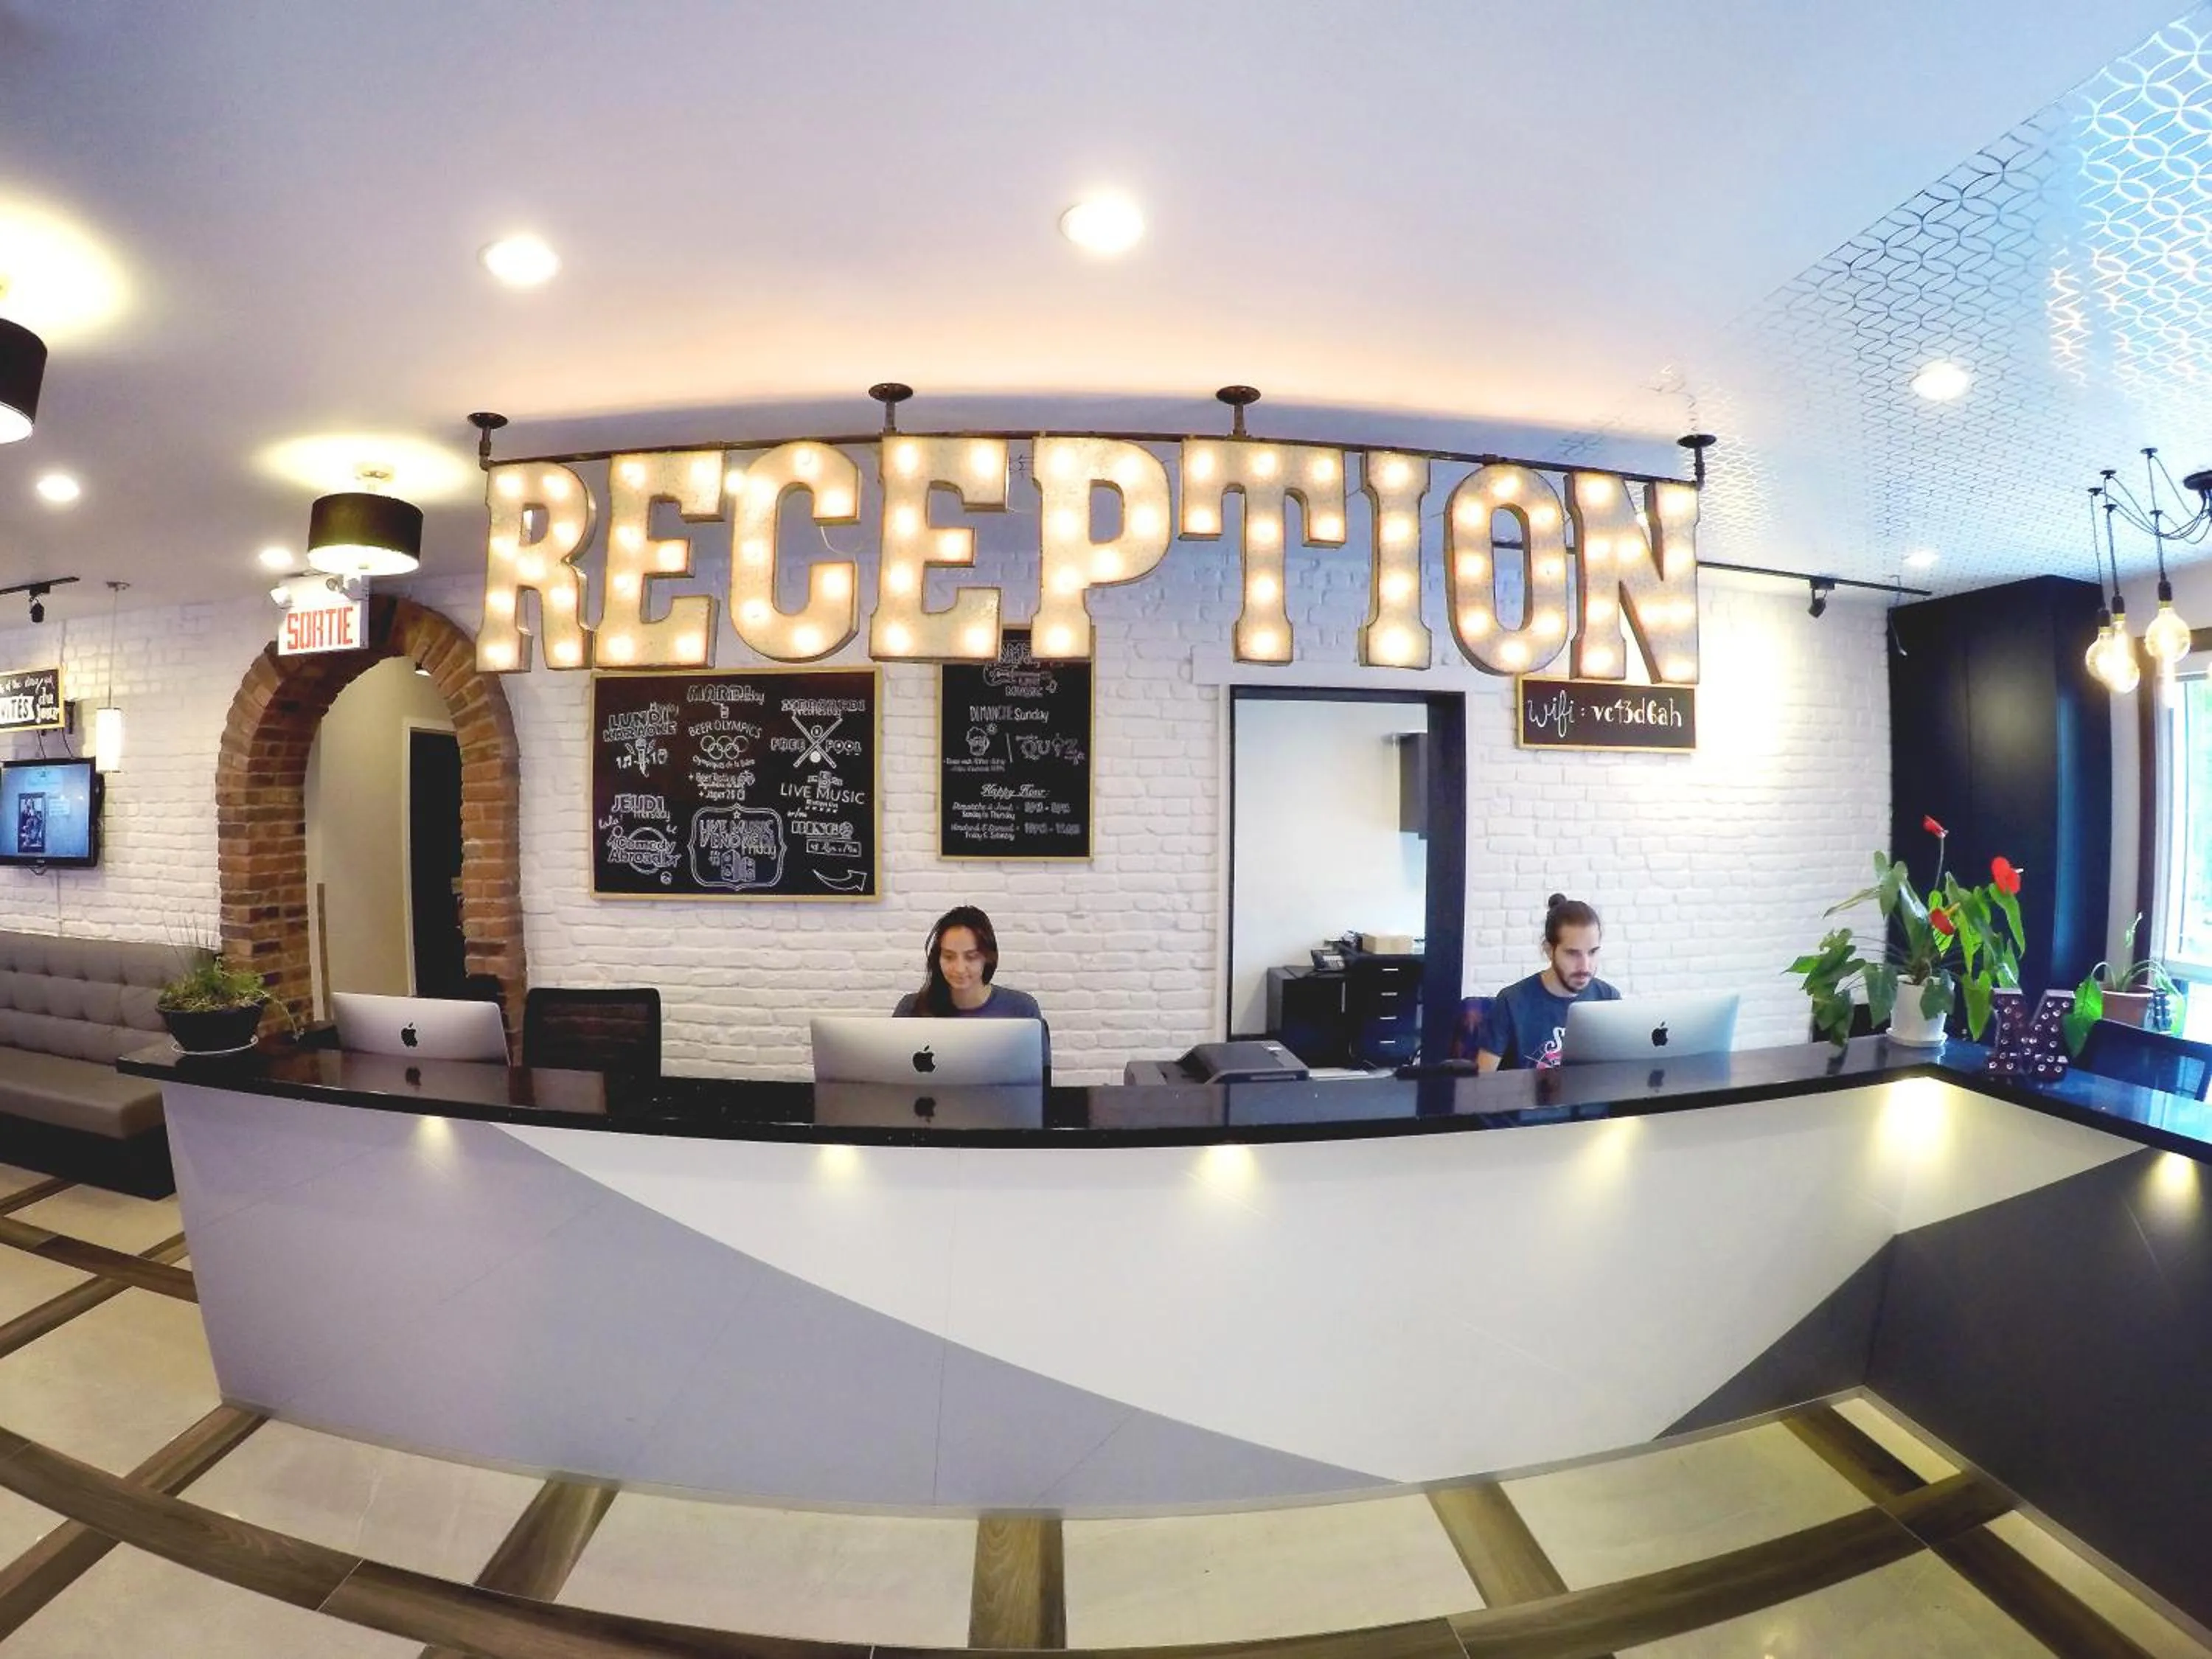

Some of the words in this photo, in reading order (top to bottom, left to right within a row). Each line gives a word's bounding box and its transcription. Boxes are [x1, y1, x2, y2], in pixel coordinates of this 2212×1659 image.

[474, 435, 1700, 685] RECEPTION
[287, 606, 354, 650] SORTIE
[686, 683, 752, 703] MARDI
[608, 709, 669, 731] LUNDI
[1014, 707, 1049, 723] Sunday
[602, 720, 678, 742] KARAOKE
[688, 721, 713, 737] BEER
[713, 719, 764, 738] OLYMPICS
[825, 740, 863, 754] POOL
[780, 782, 813, 799] LIVE
[816, 787, 866, 805] MUSIC
[981, 783, 1015, 800] Happy
[611, 793, 665, 814] JEUDI
[615, 836, 677, 855] Comedy
